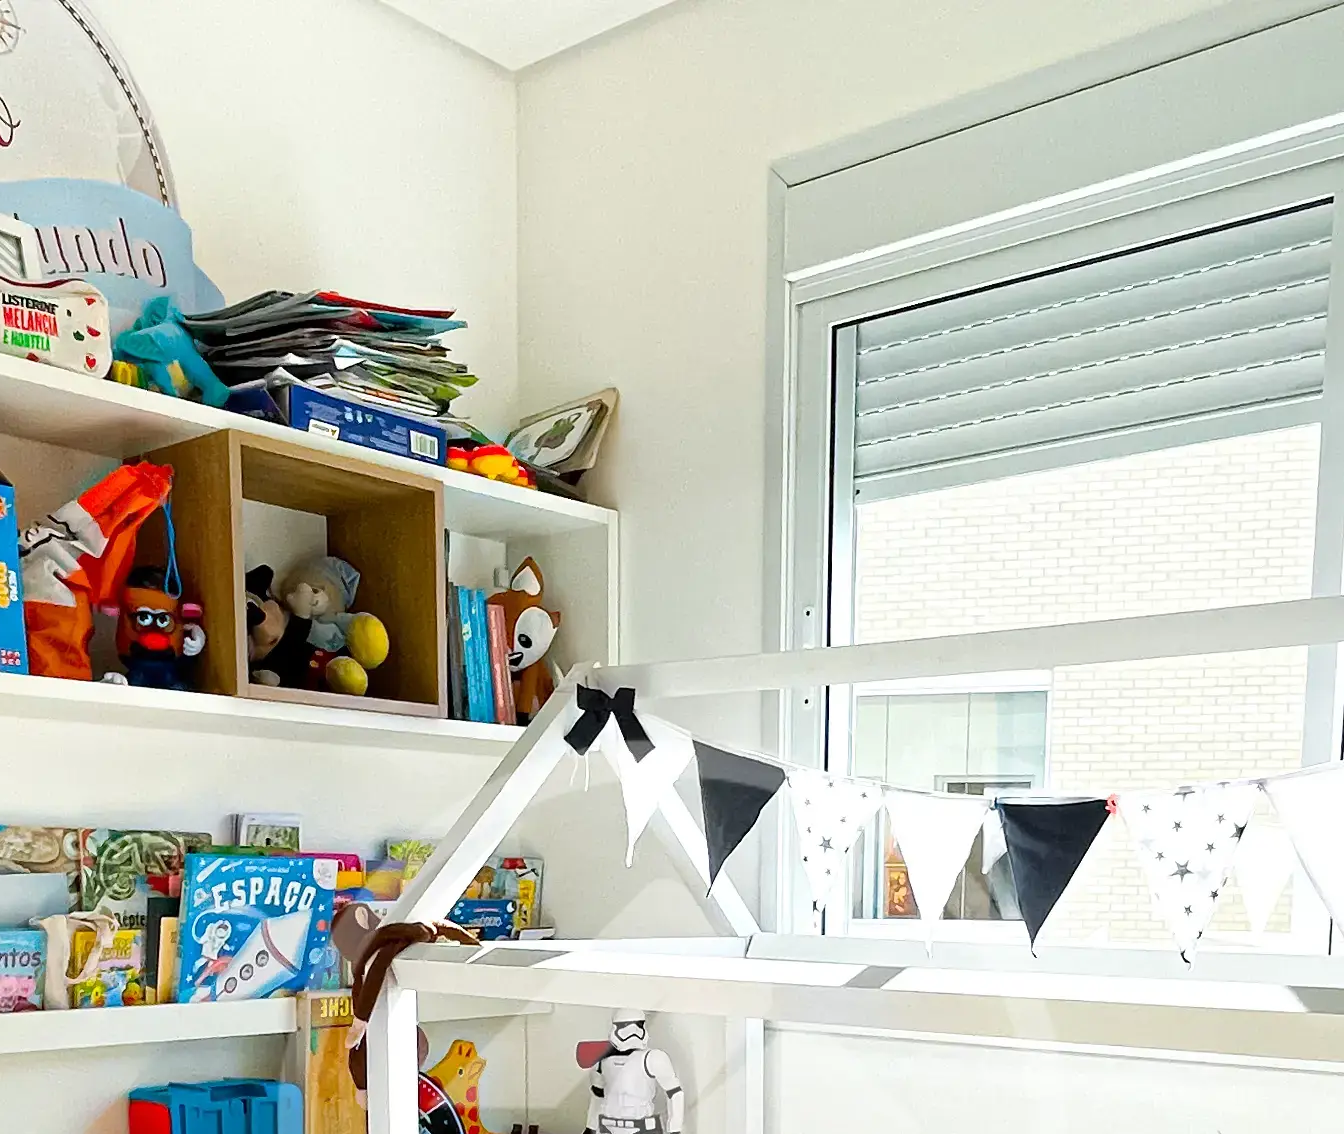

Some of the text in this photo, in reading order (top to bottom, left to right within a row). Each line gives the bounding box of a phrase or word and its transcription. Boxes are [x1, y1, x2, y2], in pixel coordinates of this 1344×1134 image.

[14, 213, 168, 289] undo
[210, 876, 317, 914] ESPAÇO
[114, 911, 147, 930] Répte
